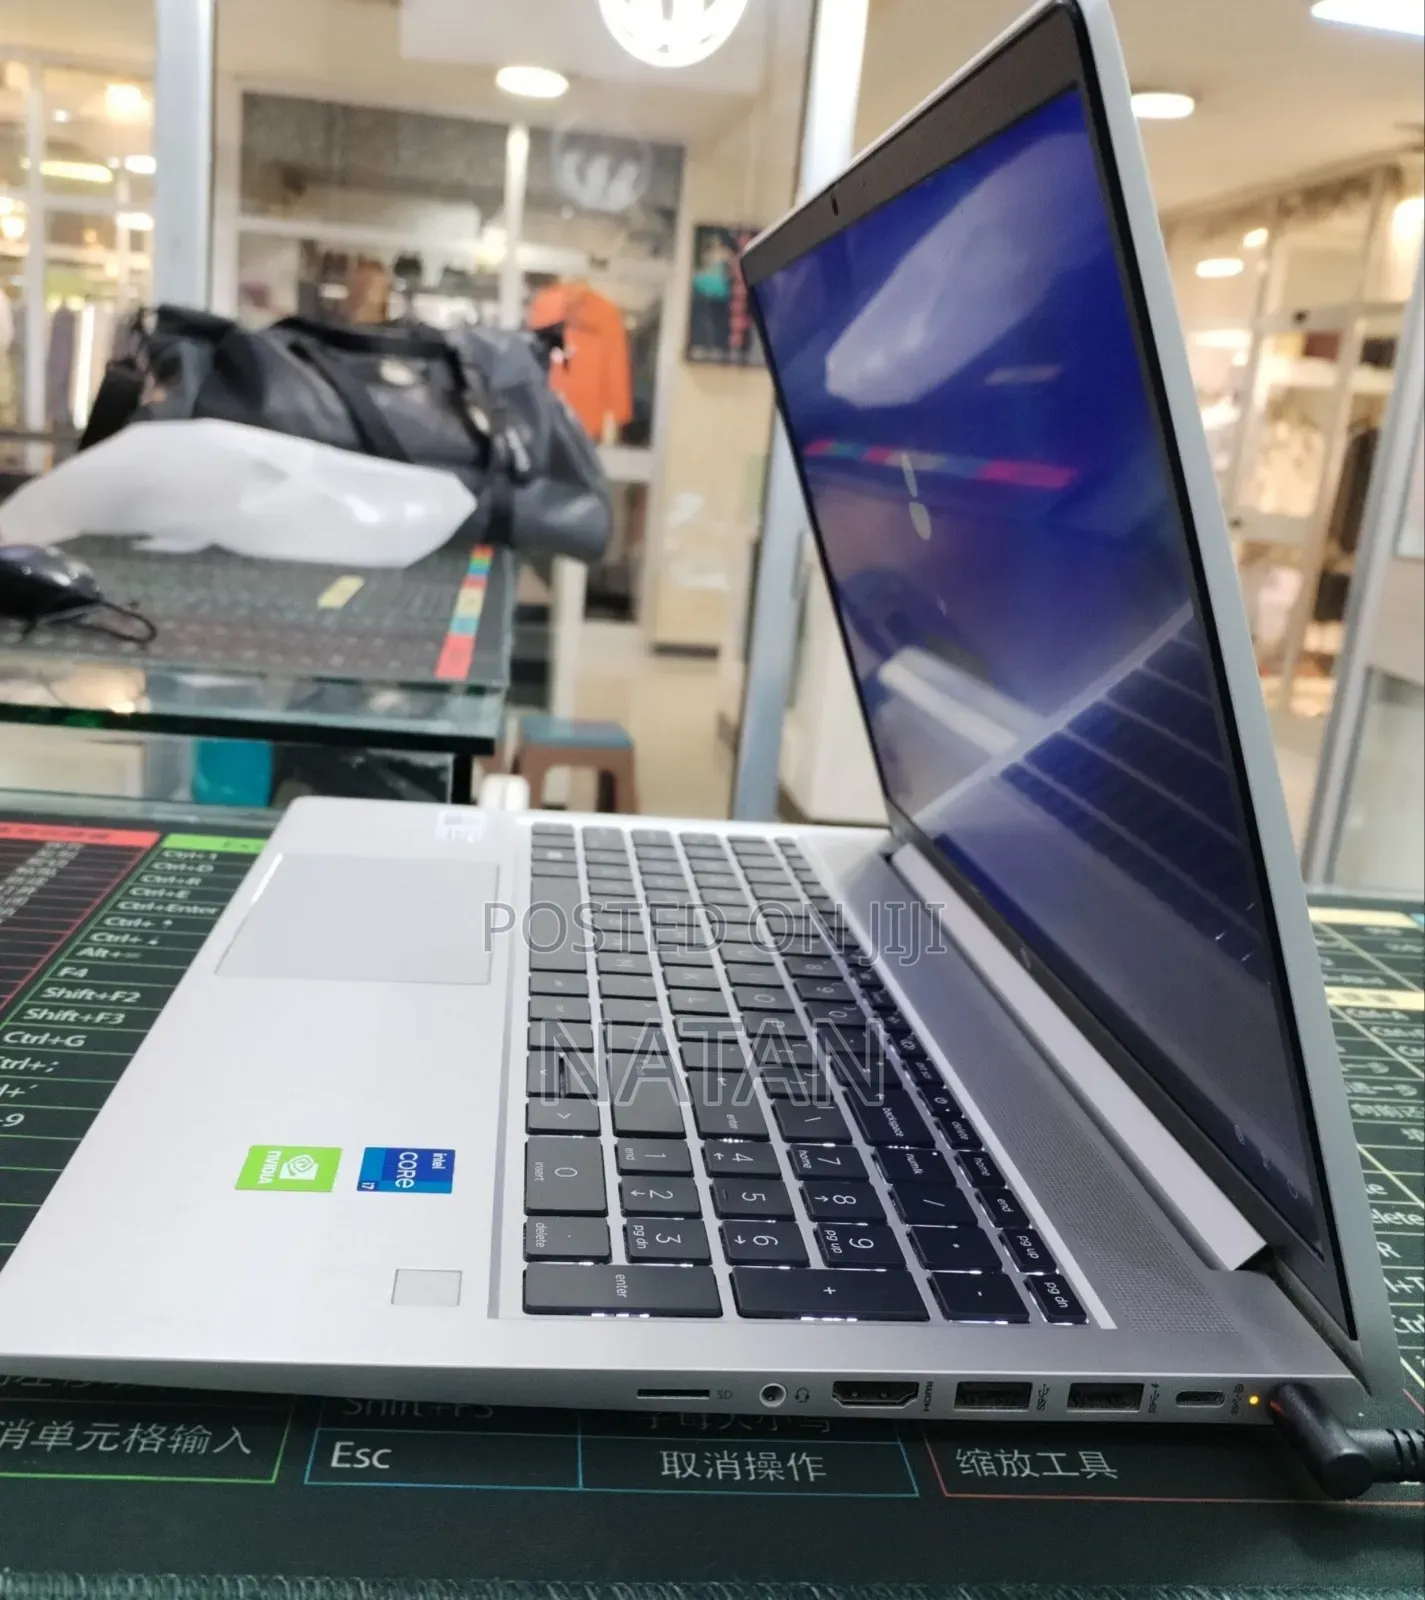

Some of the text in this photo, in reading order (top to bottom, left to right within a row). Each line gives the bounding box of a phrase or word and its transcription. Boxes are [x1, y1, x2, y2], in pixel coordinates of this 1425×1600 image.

[117, 900, 219, 915] Ctrl+Enter
[57, 966, 89, 979] F4
[40, 986, 142, 1003] Shift+F2
[22, 1007, 126, 1025] Shift+F3
[3, 1030, 88, 1048] Ctrl+G
[431, 1152, 448, 1170] intel
[624, 1147, 637, 1161] end
[731, 1152, 754, 1163] 4
[798, 1149, 813, 1170] home
[817, 1157, 842, 1167] 7
[534, 1161, 545, 1182] insert
[554, 1167, 578, 1178] 0
[649, 1189, 674, 1200] 2
[742, 1191, 766, 1202] 5
[832, 1194, 857, 1205] 8
[996, 1198, 1015, 1213] end
[536, 1222, 549, 1248] delete
[632, 1224, 647, 1250] pg dn
[655, 1232, 682, 1244] 3
[752, 1235, 779, 1246] 6
[824, 1229, 843, 1254] pg up
[848, 1237, 875, 1250] 9
[616, 1273, 628, 1298] enter
[716, 1389, 732, 1400] SD
[330, 1440, 392, 1469] Esc
[660, 1450, 827, 1481] 取消操作
[956, 1449, 1119, 1480] 缩放工具
